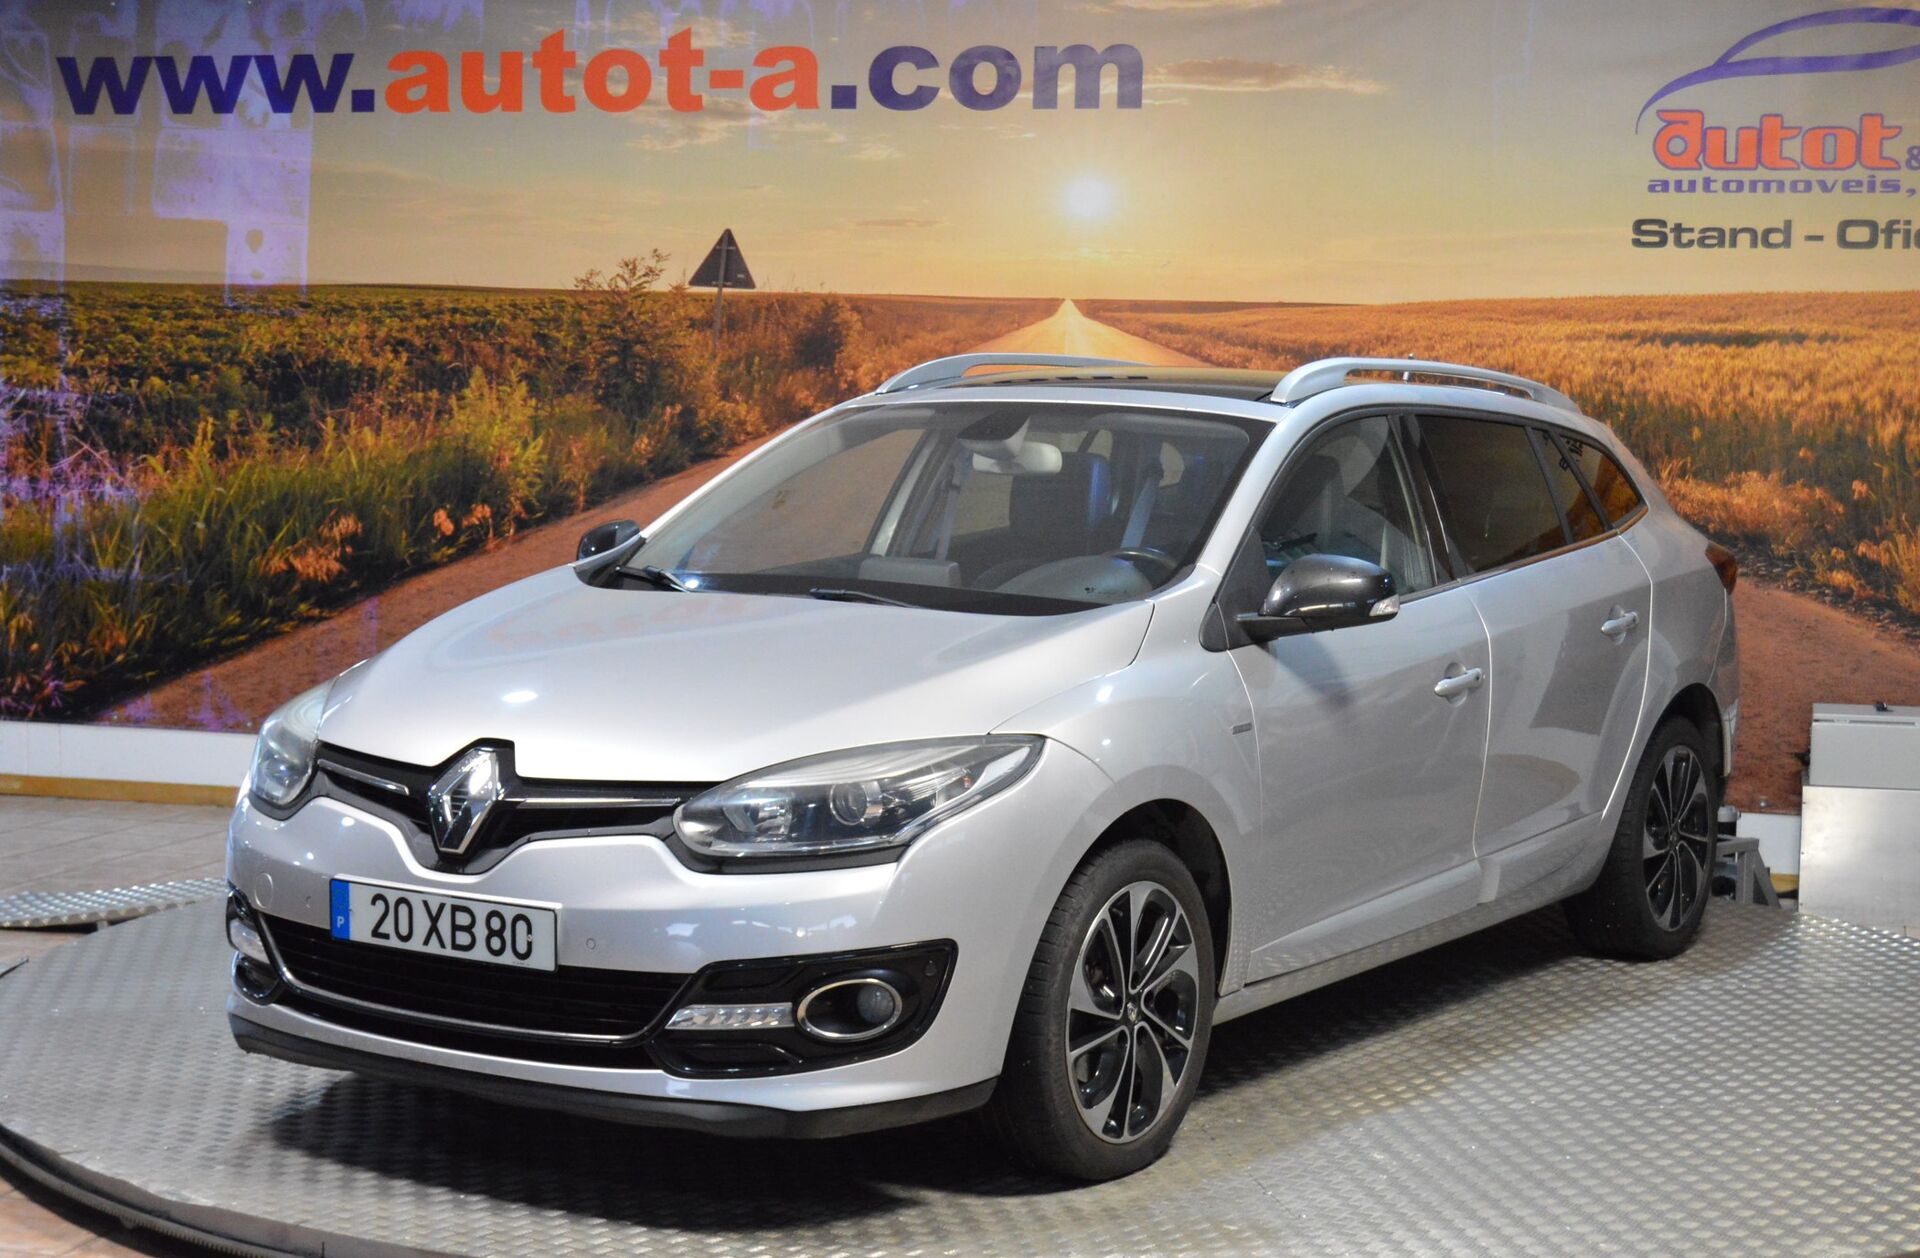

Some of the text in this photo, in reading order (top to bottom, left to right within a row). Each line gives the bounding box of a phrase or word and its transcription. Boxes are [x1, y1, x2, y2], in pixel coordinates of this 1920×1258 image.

[56, 27, 1143, 115] www.autot-a.com
[1653, 109, 1902, 171] autot
[1647, 175, 1916, 198] automoveis,
[1631, 218, 1792, 250] Stand
[1836, 219, 1920, 250] Ofi
[336, 915, 345, 929] P
